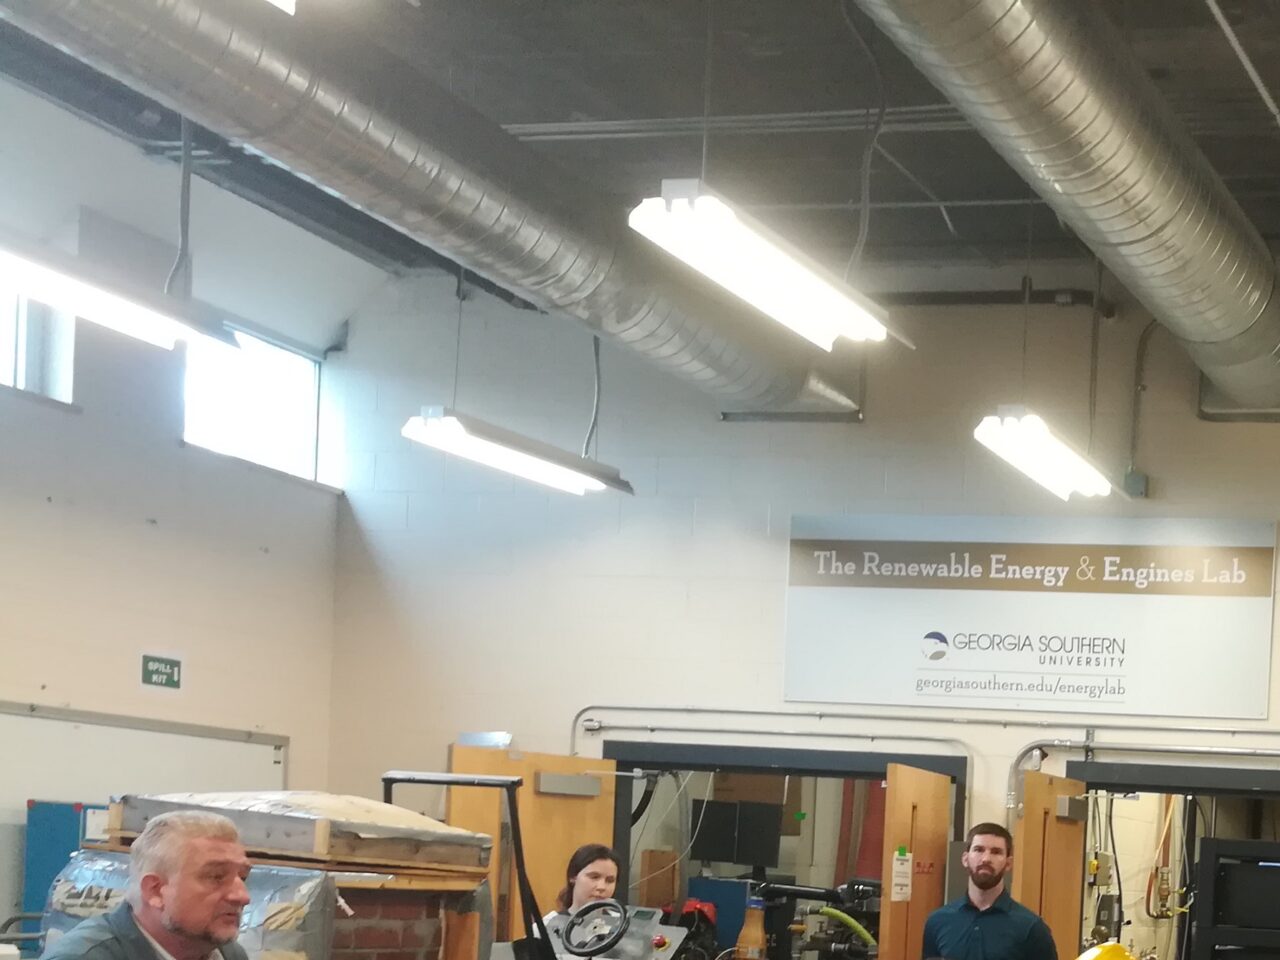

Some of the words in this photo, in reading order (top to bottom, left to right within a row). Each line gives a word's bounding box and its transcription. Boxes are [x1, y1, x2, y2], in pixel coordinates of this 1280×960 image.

[814, 551, 857, 577] The
[863, 552, 982, 579] Renewable
[989, 553, 1069, 587] Energy
[1076, 556, 1096, 581] &
[1103, 556, 1195, 588] Engines
[1201, 558, 1247, 584] Lab
[953, 633, 1034, 652] GEORGIA
[1039, 635, 1125, 655] SOUTHERN
[148, 661, 172, 672] SPILL
[1039, 655, 1125, 668] UNIVERSITY
[152, 673, 167, 684] KIT
[916, 674, 1126, 698] georgiasouthern.edu/energylab
